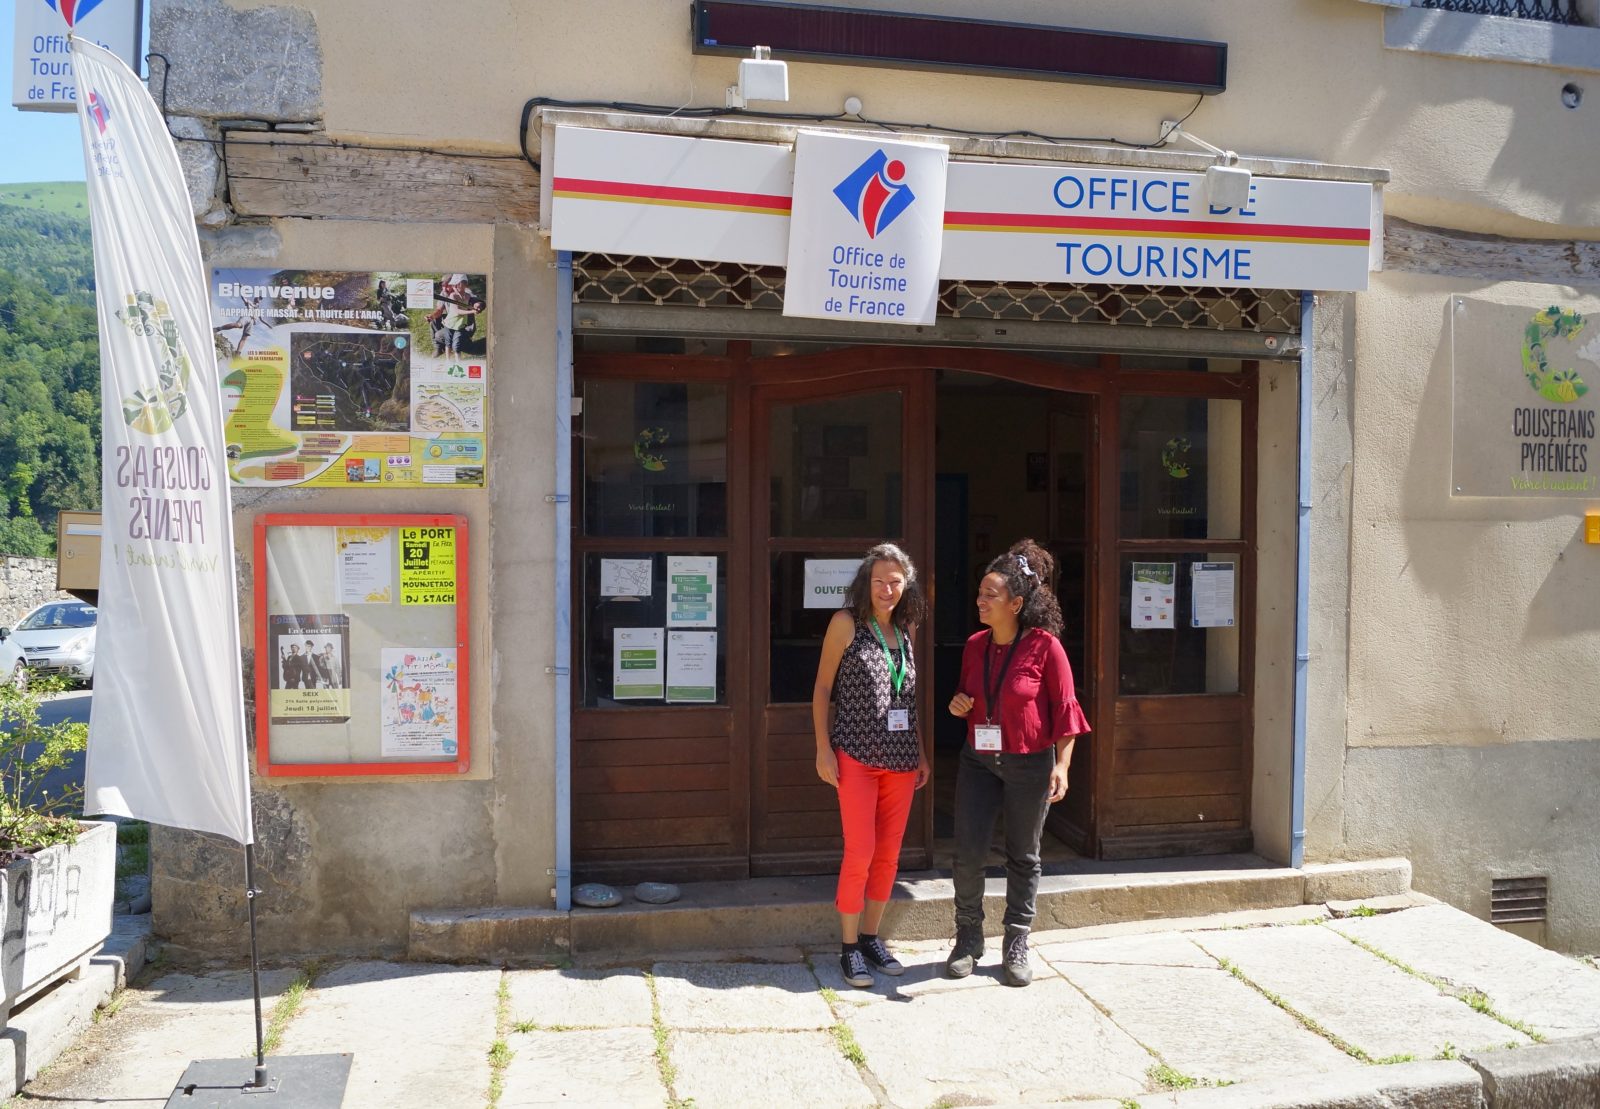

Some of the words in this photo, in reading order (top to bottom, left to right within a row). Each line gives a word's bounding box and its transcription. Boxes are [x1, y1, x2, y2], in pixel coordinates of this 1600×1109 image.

[30, 58, 74, 76] Touri
[28, 85, 45, 100] de
[1053, 176, 1190, 213] OFFICE
[832, 245, 884, 267] Office
[889, 253, 906, 269] de
[1056, 242, 1251, 280] TOURISME
[828, 268, 907, 292] Tourisme
[218, 283, 335, 300] Bienvenue
[220, 308, 253, 318] AAPPMA
[255, 309, 265, 318] DE
[266, 308, 299, 318] MASSAT
[304, 309, 314, 318] LA
[315, 309, 343, 319] TRUITE
[344, 310, 354, 319] DE
[824, 297, 842, 313] de
[848, 295, 906, 317] France
[1514, 407, 1595, 439] COUSERANS
[1521, 437, 1588, 473] PYRÉNÉES
[402, 529, 417, 539] Le
[420, 528, 453, 539] PORT
[409, 548, 423, 558] 20
[404, 558, 429, 567] Juillet
[405, 595, 419, 603] DJ
[423, 594, 455, 603] STACH
